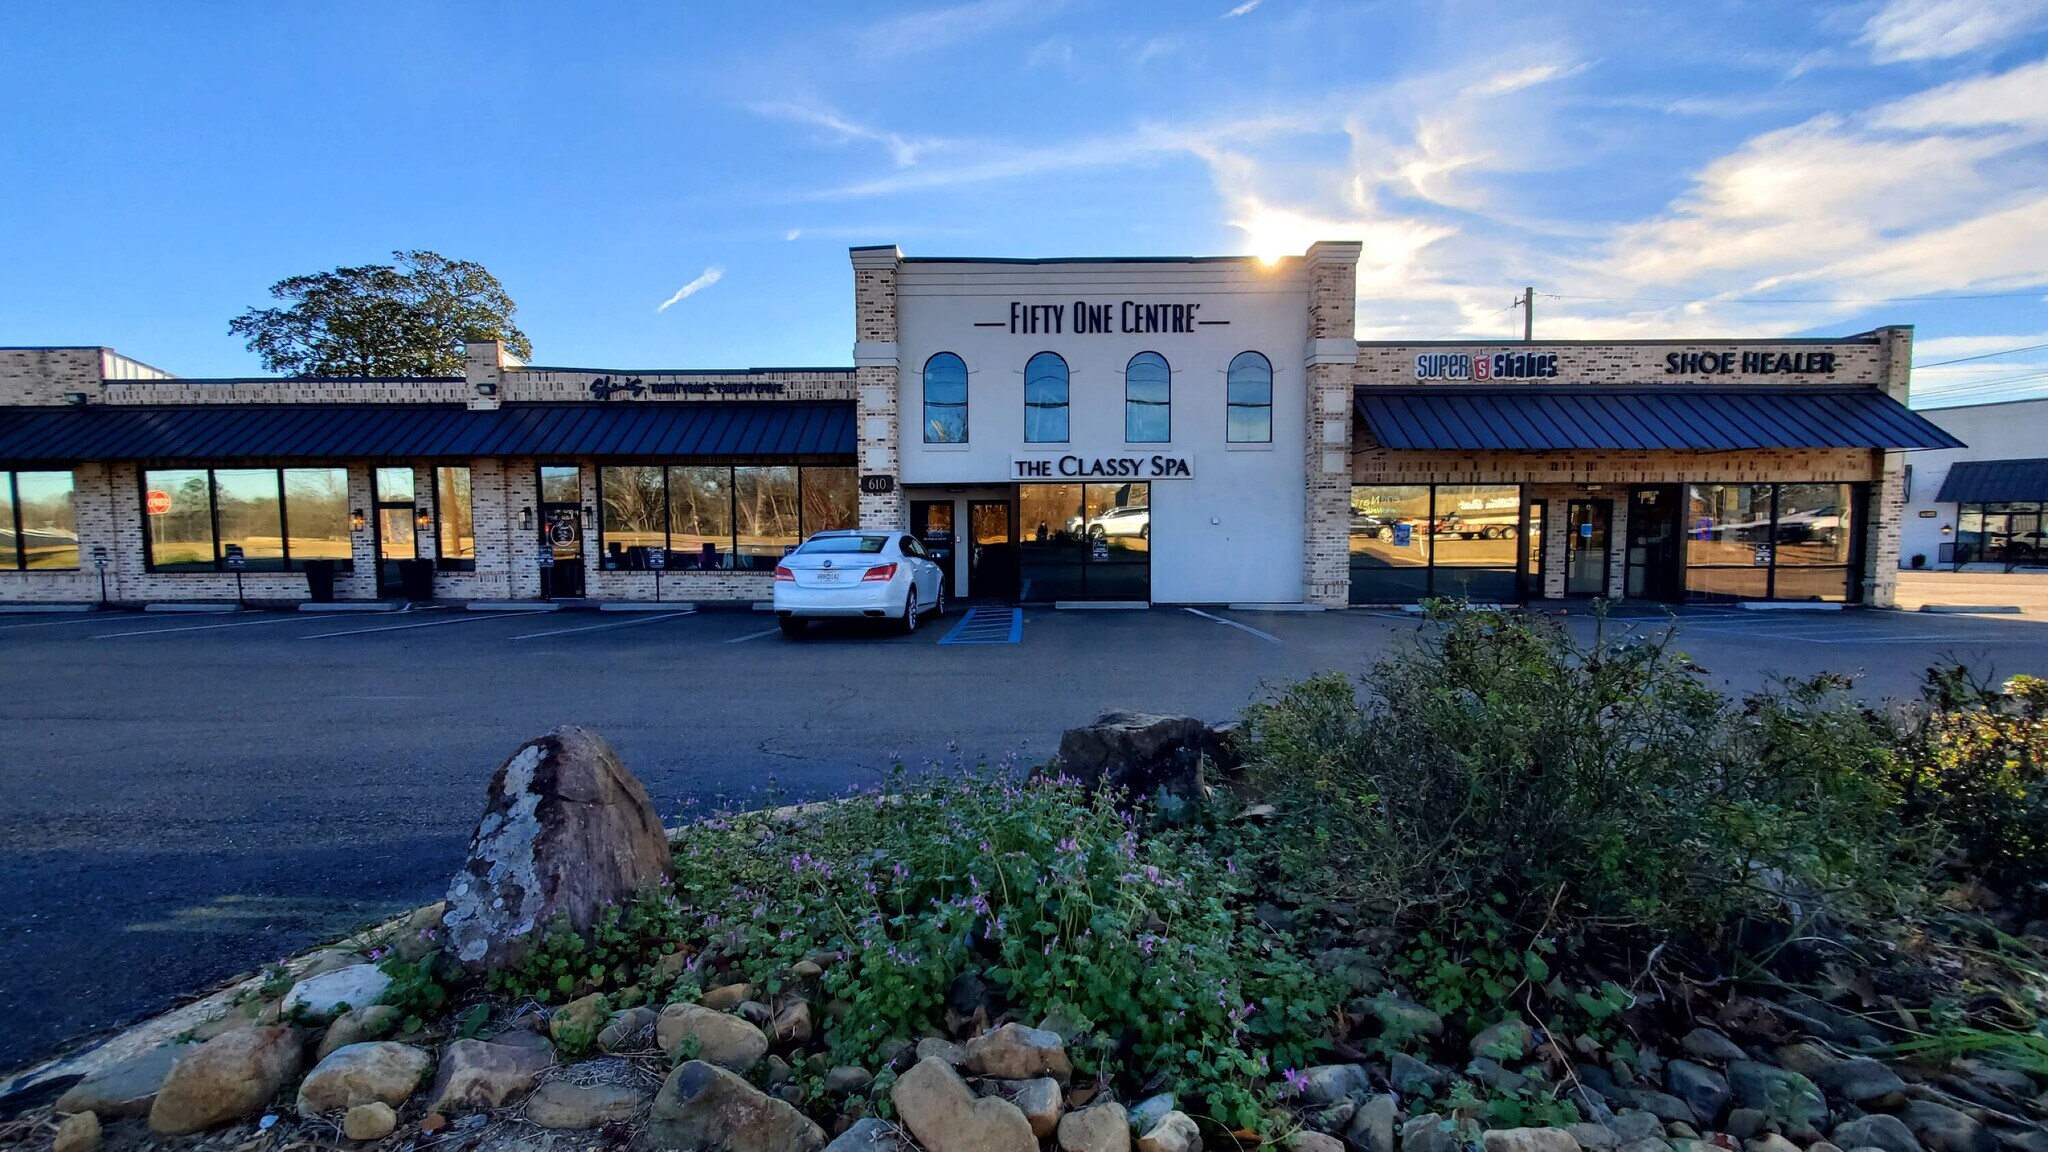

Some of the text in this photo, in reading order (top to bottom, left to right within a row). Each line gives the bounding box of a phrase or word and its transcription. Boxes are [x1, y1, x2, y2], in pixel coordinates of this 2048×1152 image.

[1010, 302, 1064, 334] FIFTY
[1073, 301, 1113, 334] ONE
[1665, 351, 1837, 375] SHOE HEALER
[1015, 455, 1191, 477] THE CLASSY SPA
[868, 477, 887, 490] 610
